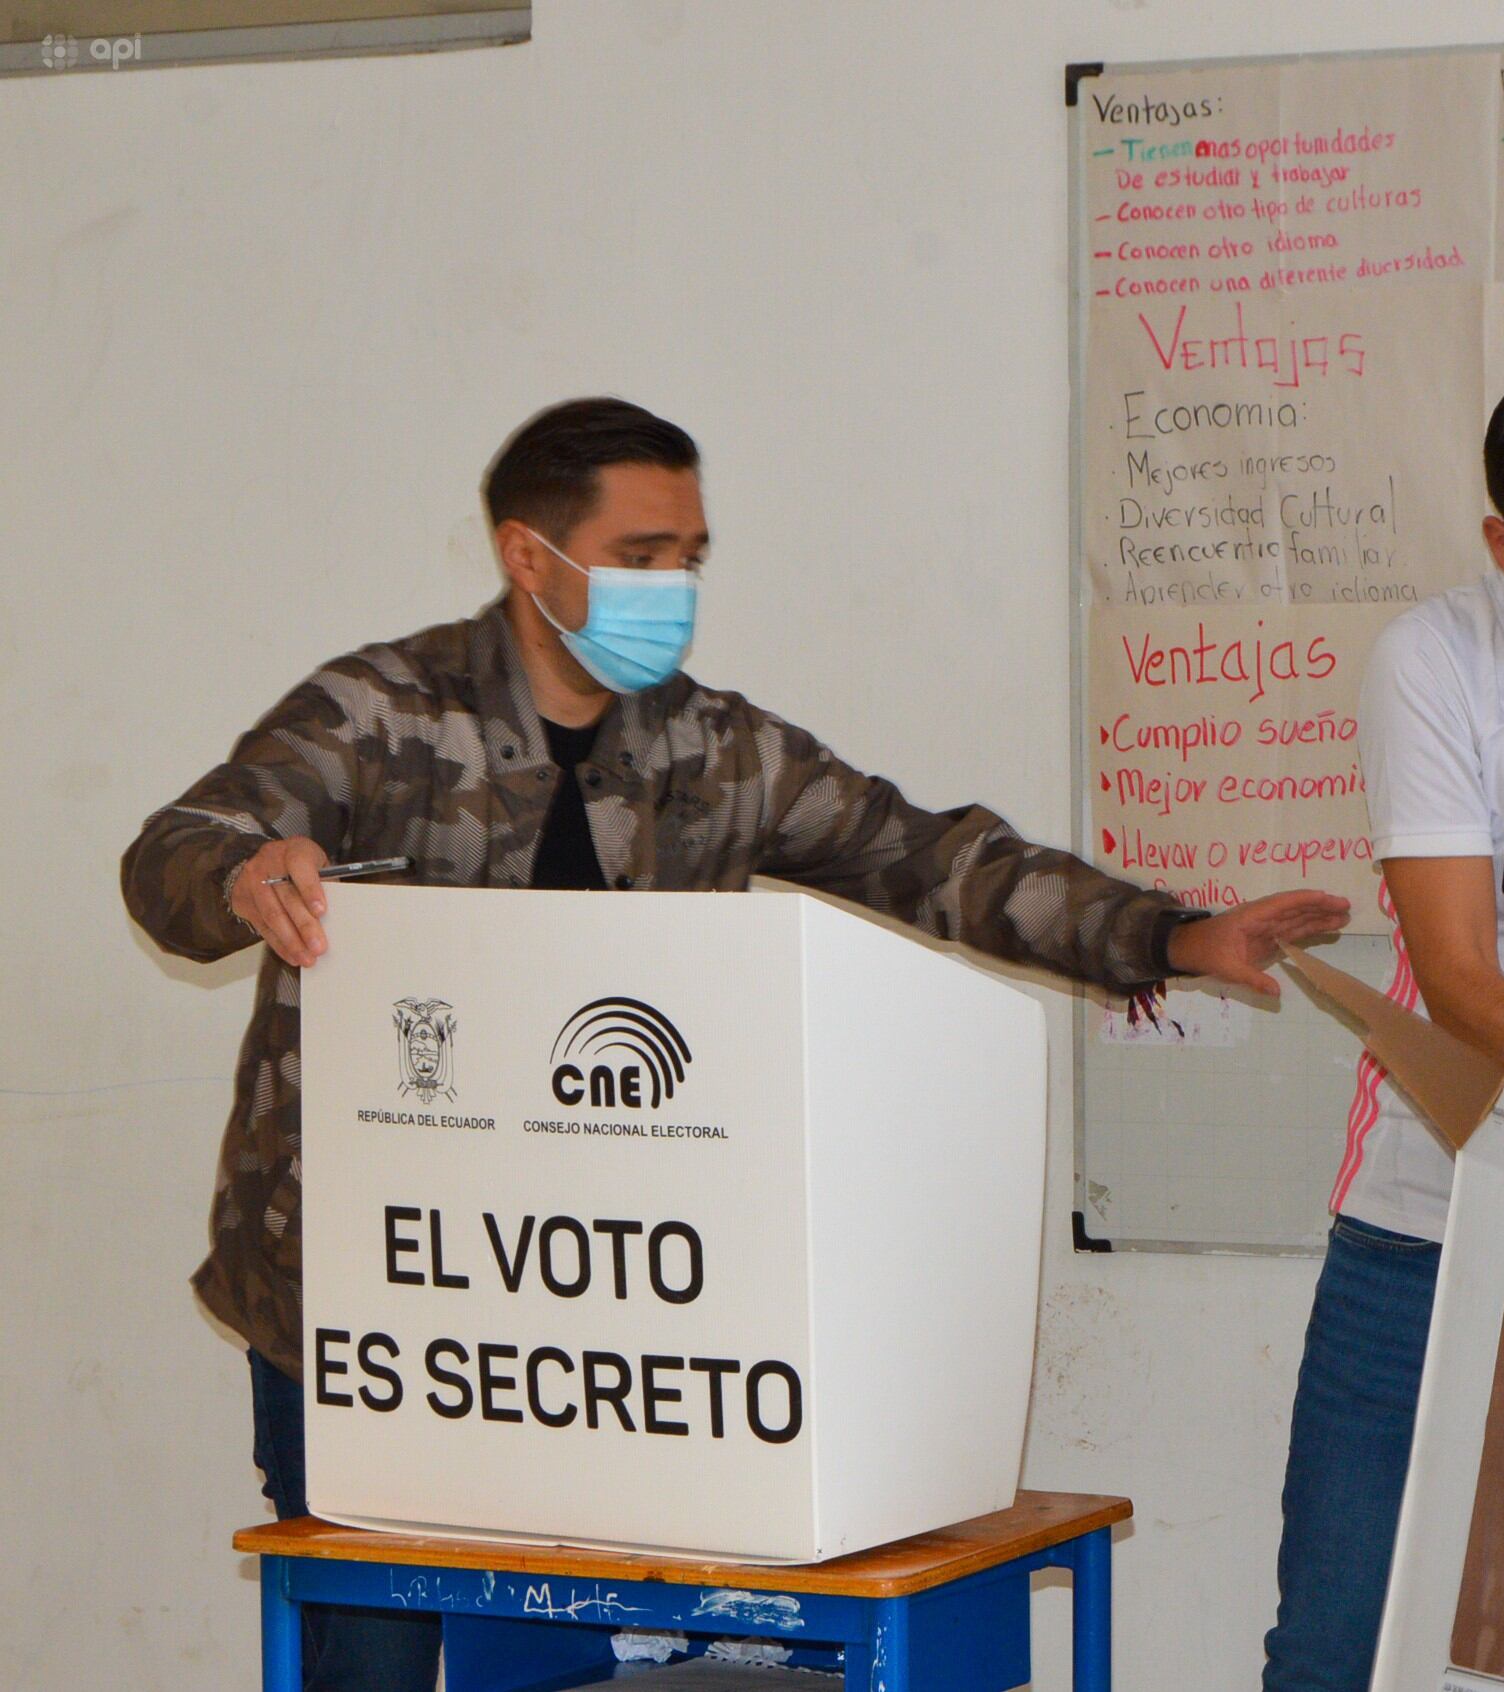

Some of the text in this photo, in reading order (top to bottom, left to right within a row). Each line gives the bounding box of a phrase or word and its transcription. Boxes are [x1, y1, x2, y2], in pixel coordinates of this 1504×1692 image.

[1092, 93, 1224, 125] Ventajas:
[1116, 202, 1196, 223] Conocen
[1117, 231, 1339, 261] Conocen otro idioma
[1115, 276, 1200, 298] Conocen
[1210, 273, 1251, 292] una
[1119, 495, 1265, 529] Diversidad
[1331, 575, 1418, 604] idioma
[1122, 620, 1336, 703] Ventajas
[1112, 713, 1242, 762] Cumplio
[1116, 767, 1208, 816] Mejor
[1121, 824, 1198, 870] Llevar
[1207, 841, 1228, 869] o
[357, 1108, 495, 1131] REPÚBLICA DEL ECUADOR
[523, 1119, 729, 1140] CONSEJO NACIONAL ELECTORAL
[385, 1205, 704, 1305] EL VOTO
[315, 1327, 803, 1445] ES SECRETO
